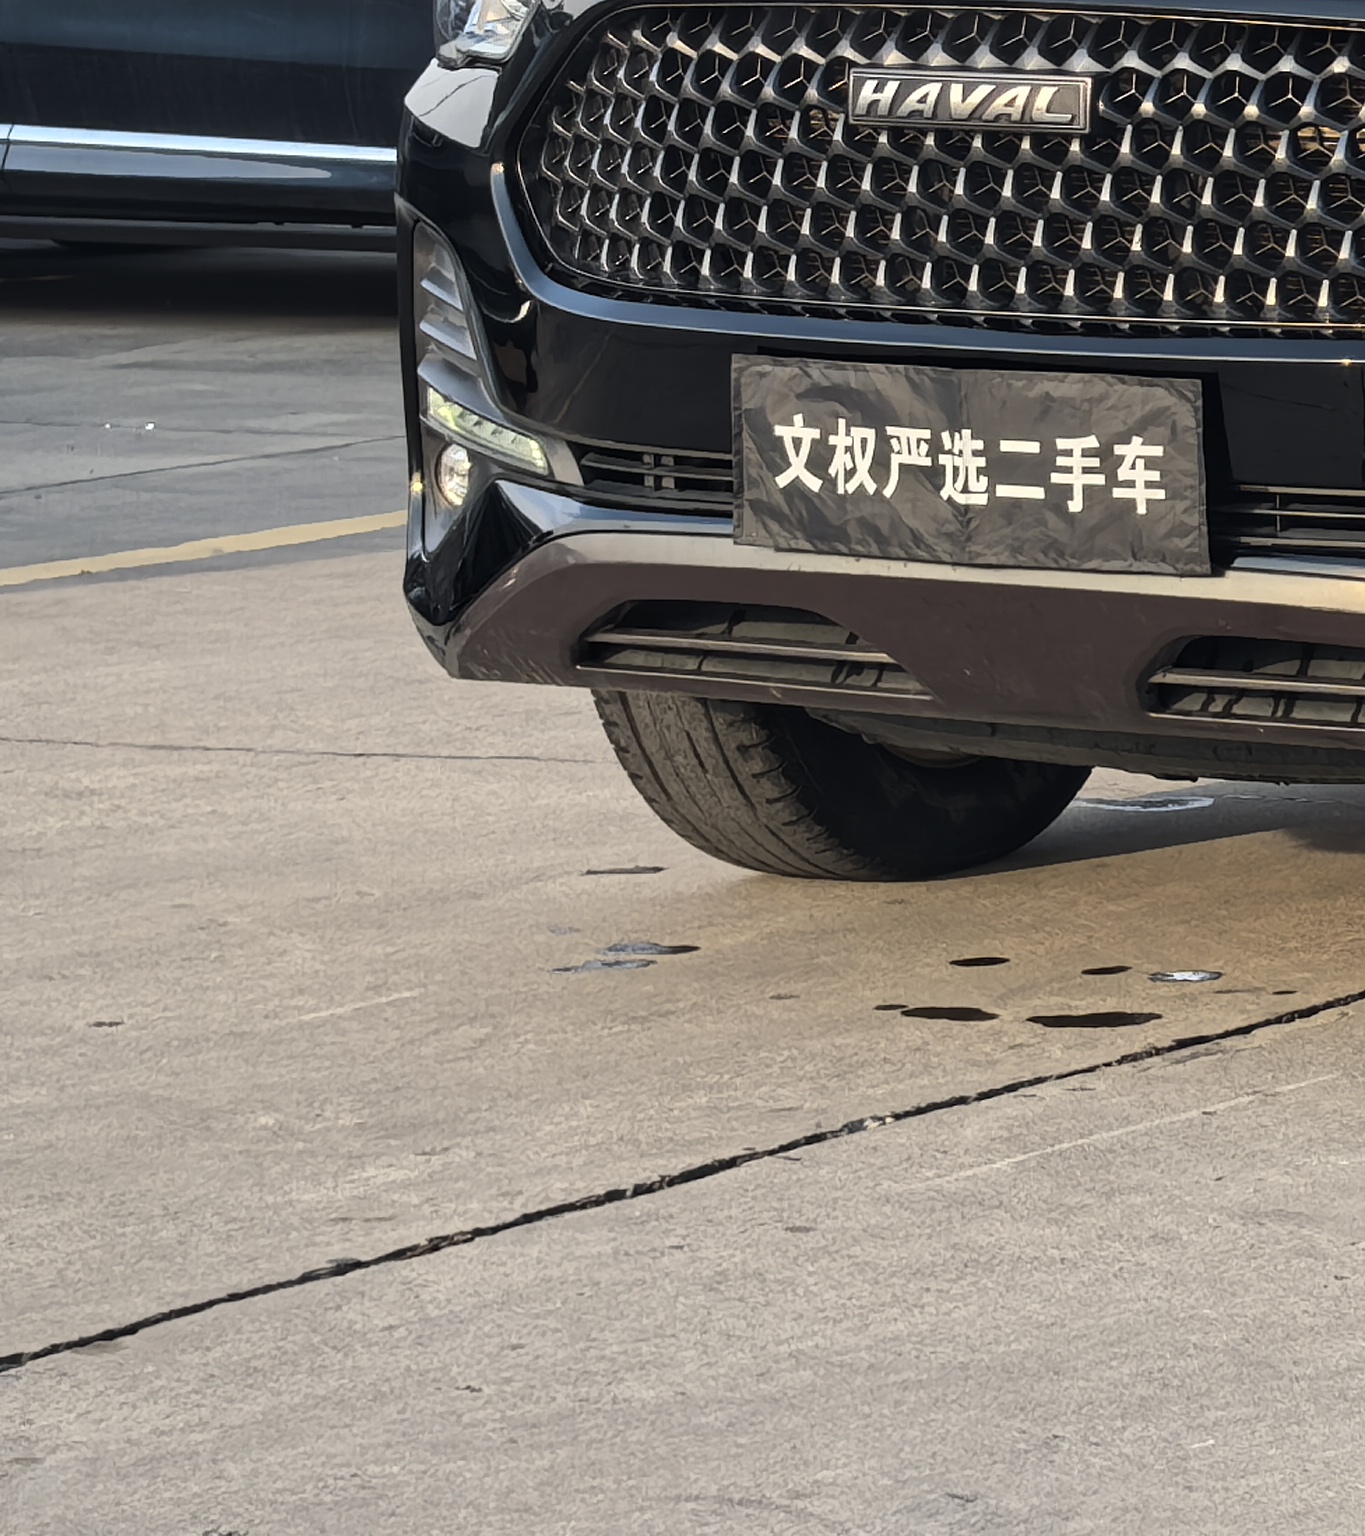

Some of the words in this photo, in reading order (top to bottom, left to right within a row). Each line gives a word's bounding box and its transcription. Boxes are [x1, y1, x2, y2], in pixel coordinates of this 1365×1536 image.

[855, 79, 1073, 123] HAVAL
[773, 413, 1167, 515] 文权严选二手车
